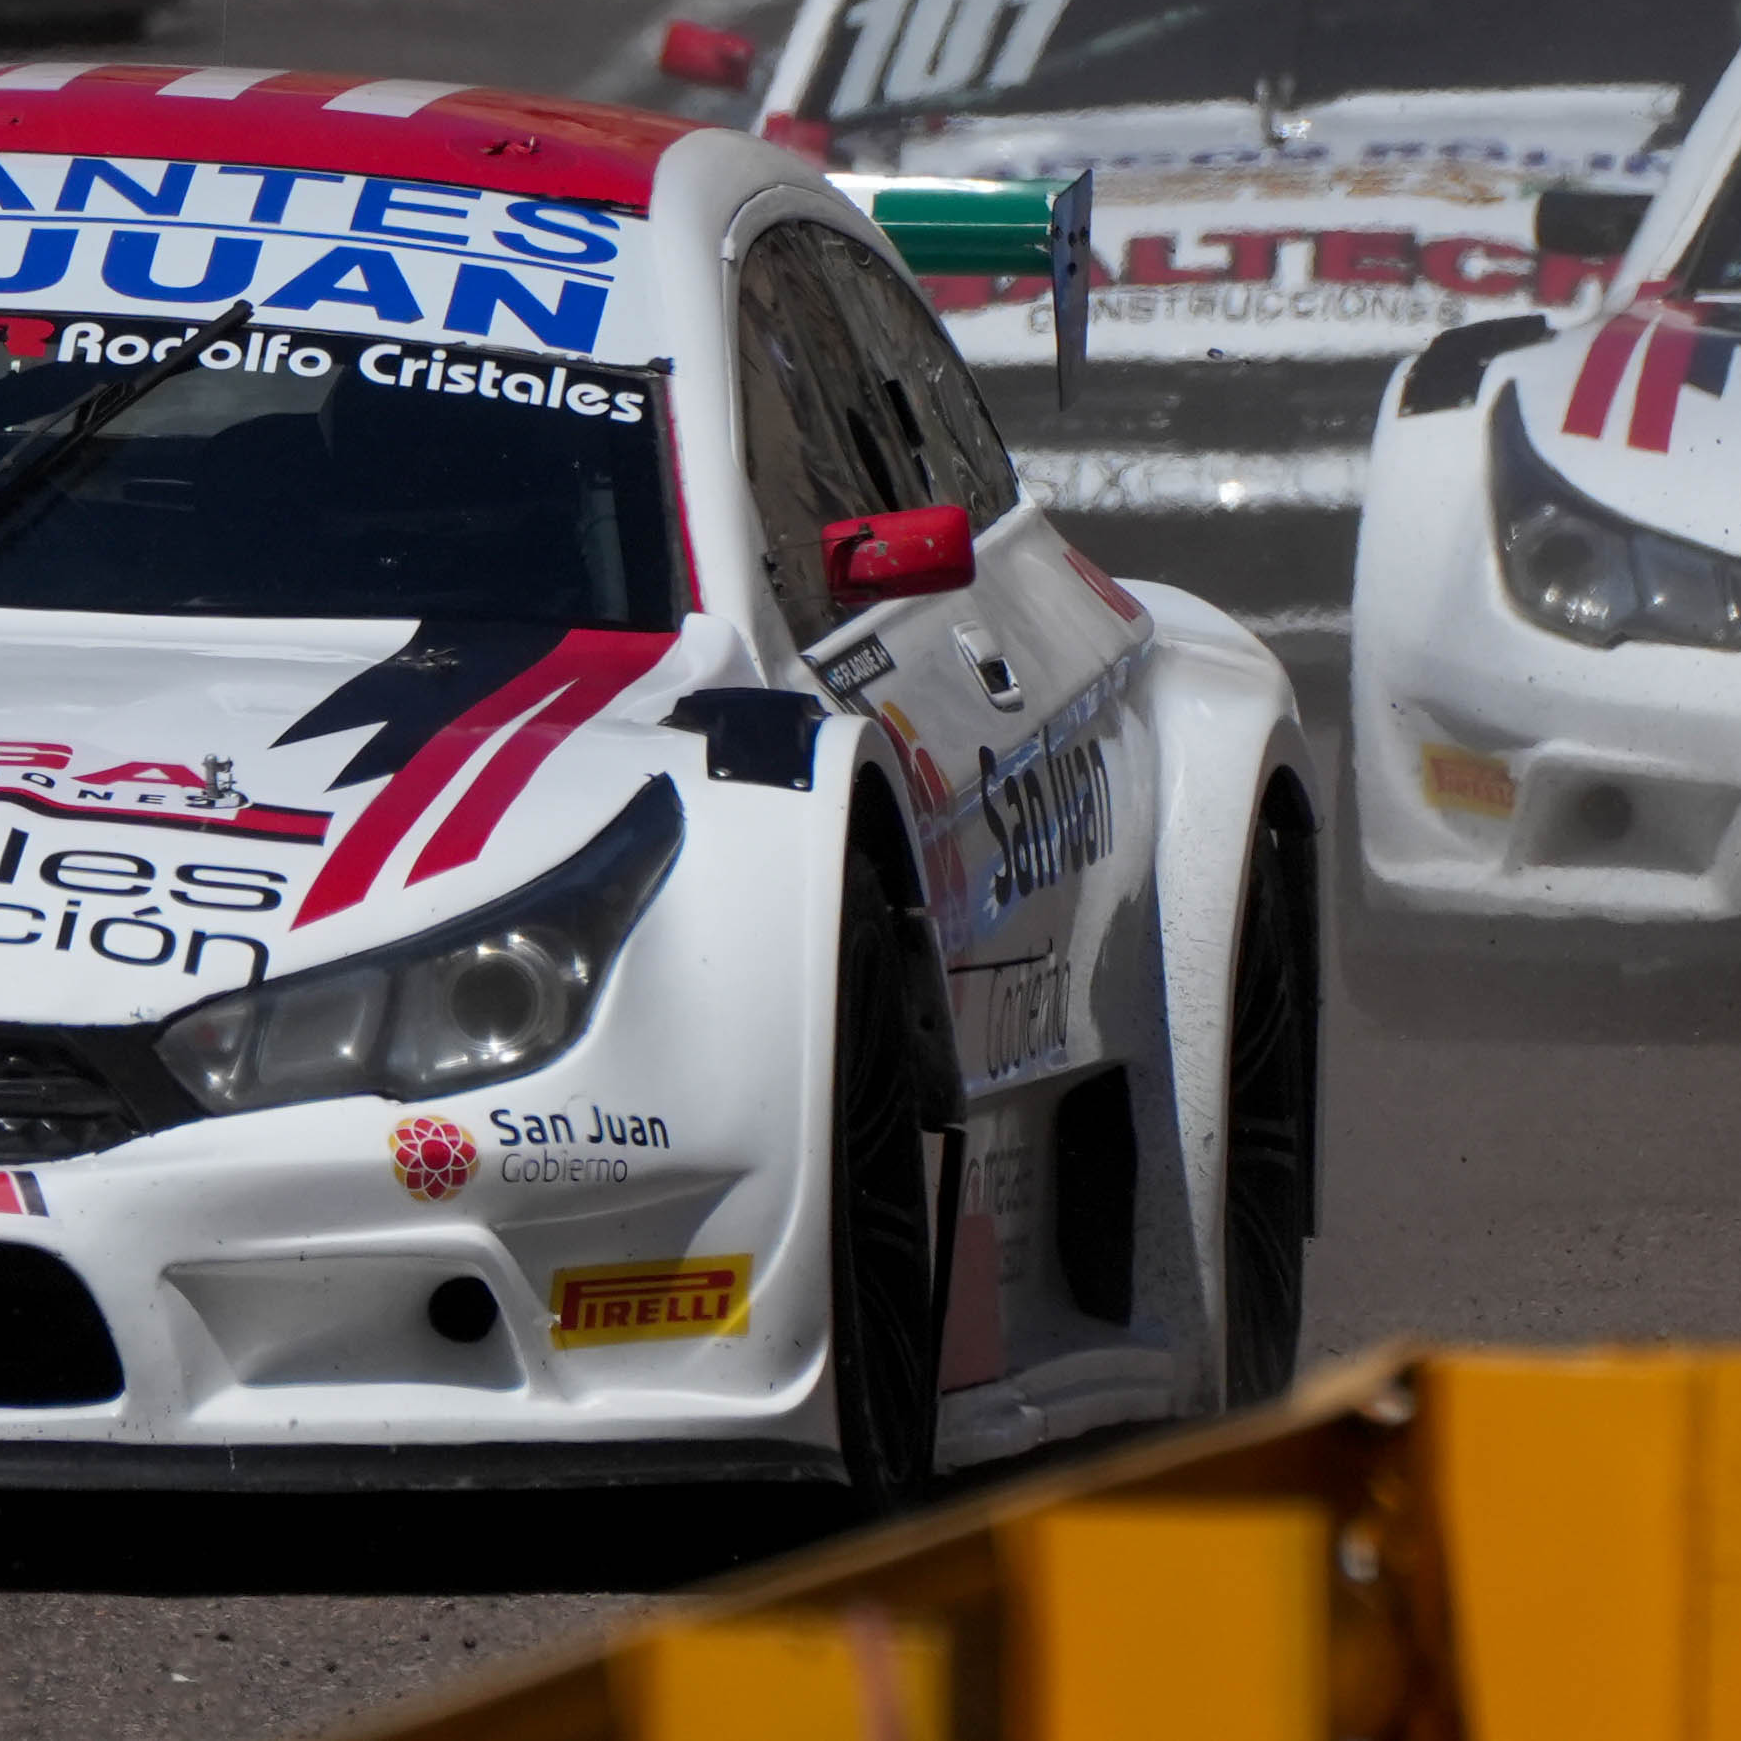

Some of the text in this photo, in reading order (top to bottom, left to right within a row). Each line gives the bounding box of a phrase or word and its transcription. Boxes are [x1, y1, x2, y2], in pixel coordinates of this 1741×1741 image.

[1026, 281, 1464, 337] CNSTRUCCIONES
[360, 344, 645, 424] Cristales
[979, 745, 1055, 907] San
[490, 1105, 670, 1149] San Juan
[502, 1152, 628, 1184] Gobierno
[561, 1268, 737, 1332] PIRELLI
